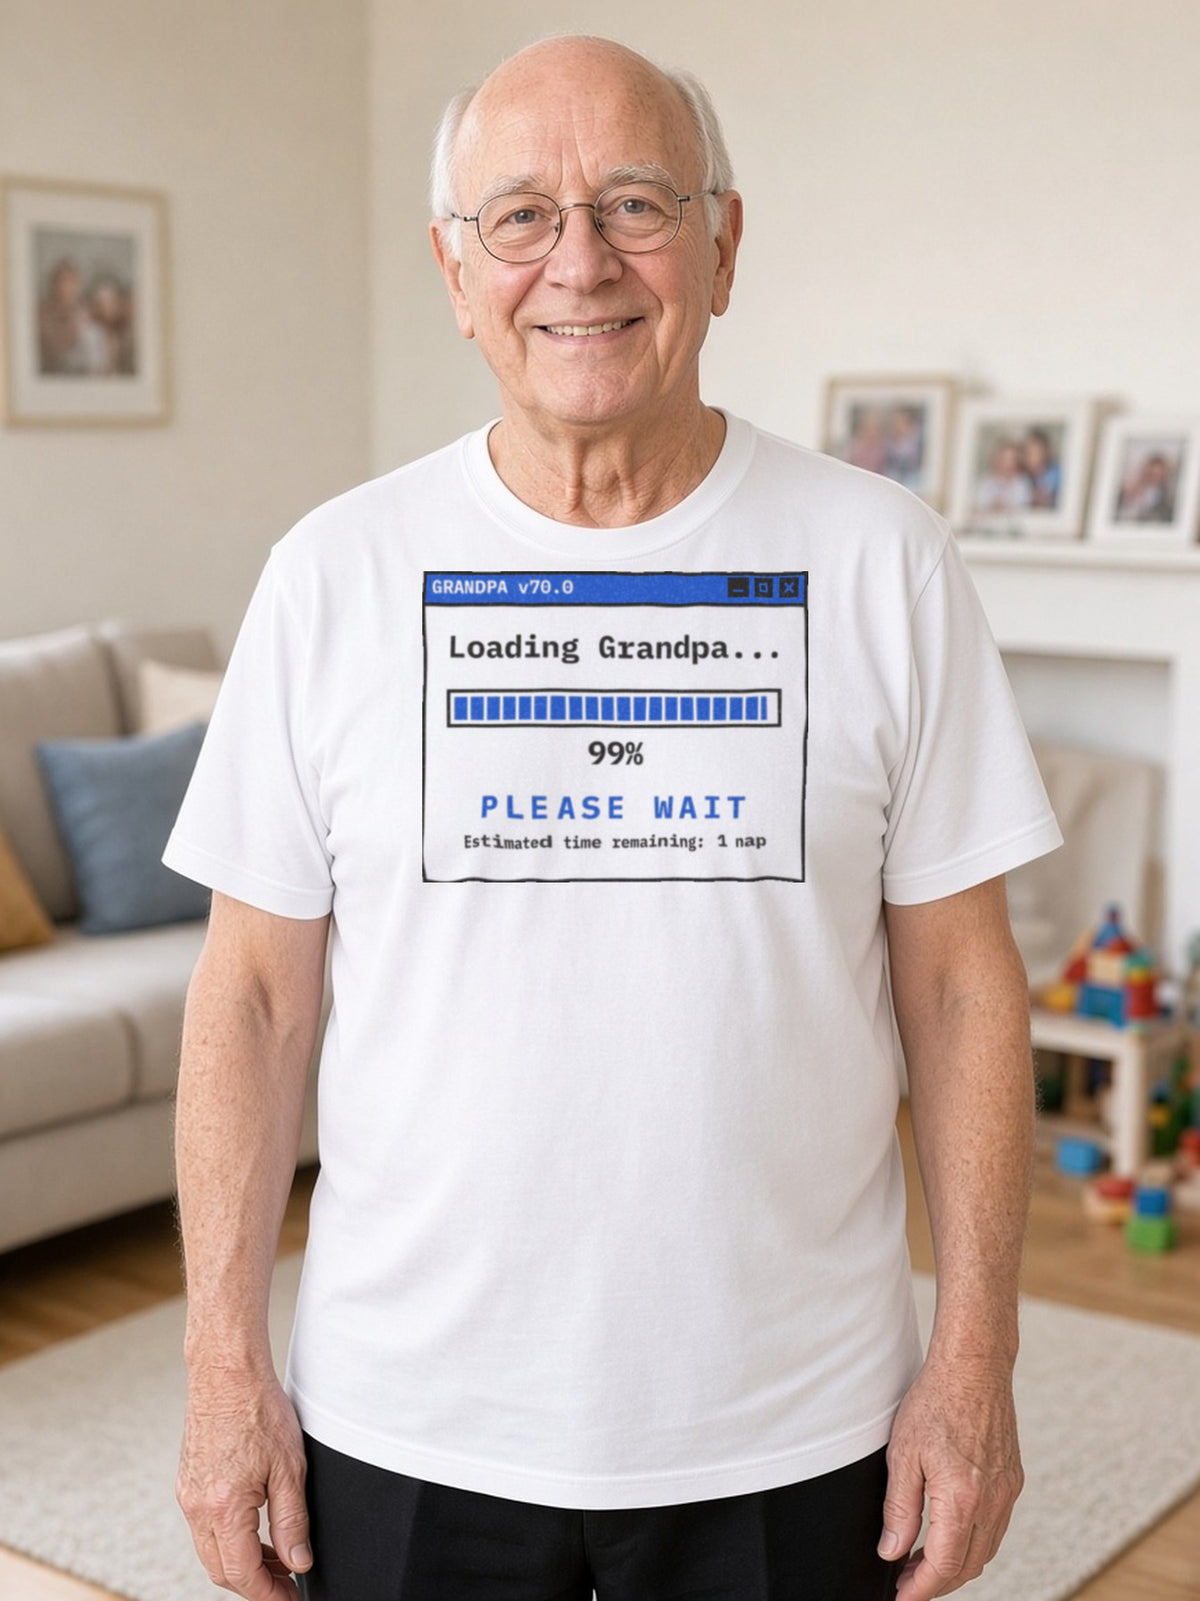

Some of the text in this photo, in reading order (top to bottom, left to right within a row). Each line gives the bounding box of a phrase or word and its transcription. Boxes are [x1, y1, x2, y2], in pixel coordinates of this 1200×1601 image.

[431, 579, 575, 595] GRANDPA v70.0
[450, 633, 780, 665] Loading Grandpa...
[588, 740, 644, 767] 99%
[481, 794, 747, 820] PLEASE WAIT
[463, 833, 767, 853] Estimated time remaining: 1 nap
